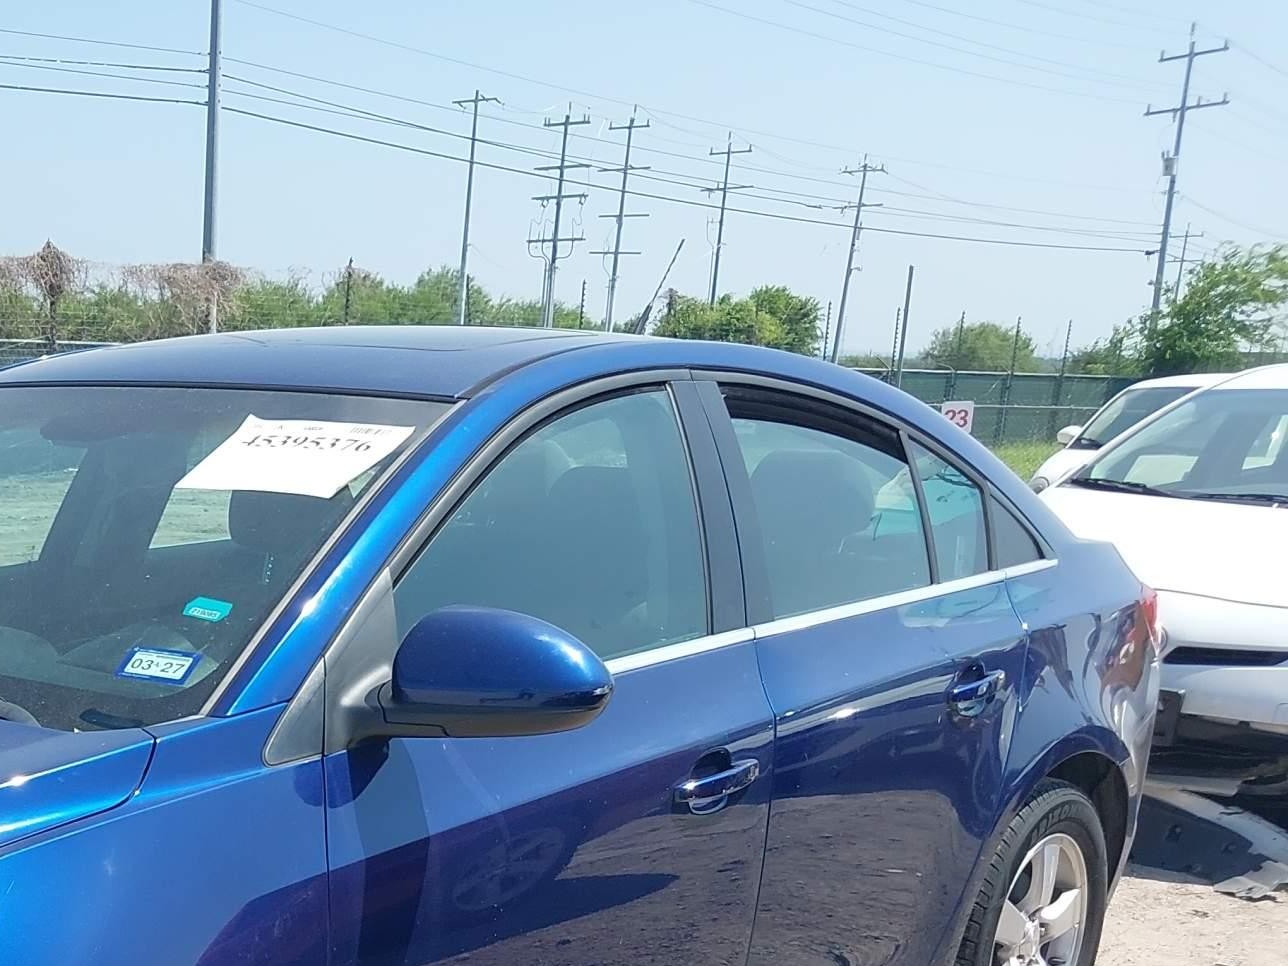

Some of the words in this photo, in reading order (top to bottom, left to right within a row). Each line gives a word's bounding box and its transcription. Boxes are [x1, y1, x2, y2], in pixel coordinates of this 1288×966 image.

[240, 433, 372, 452] 45395376
[131, 658, 154, 671] 03
[160, 662, 186, 674] 27
